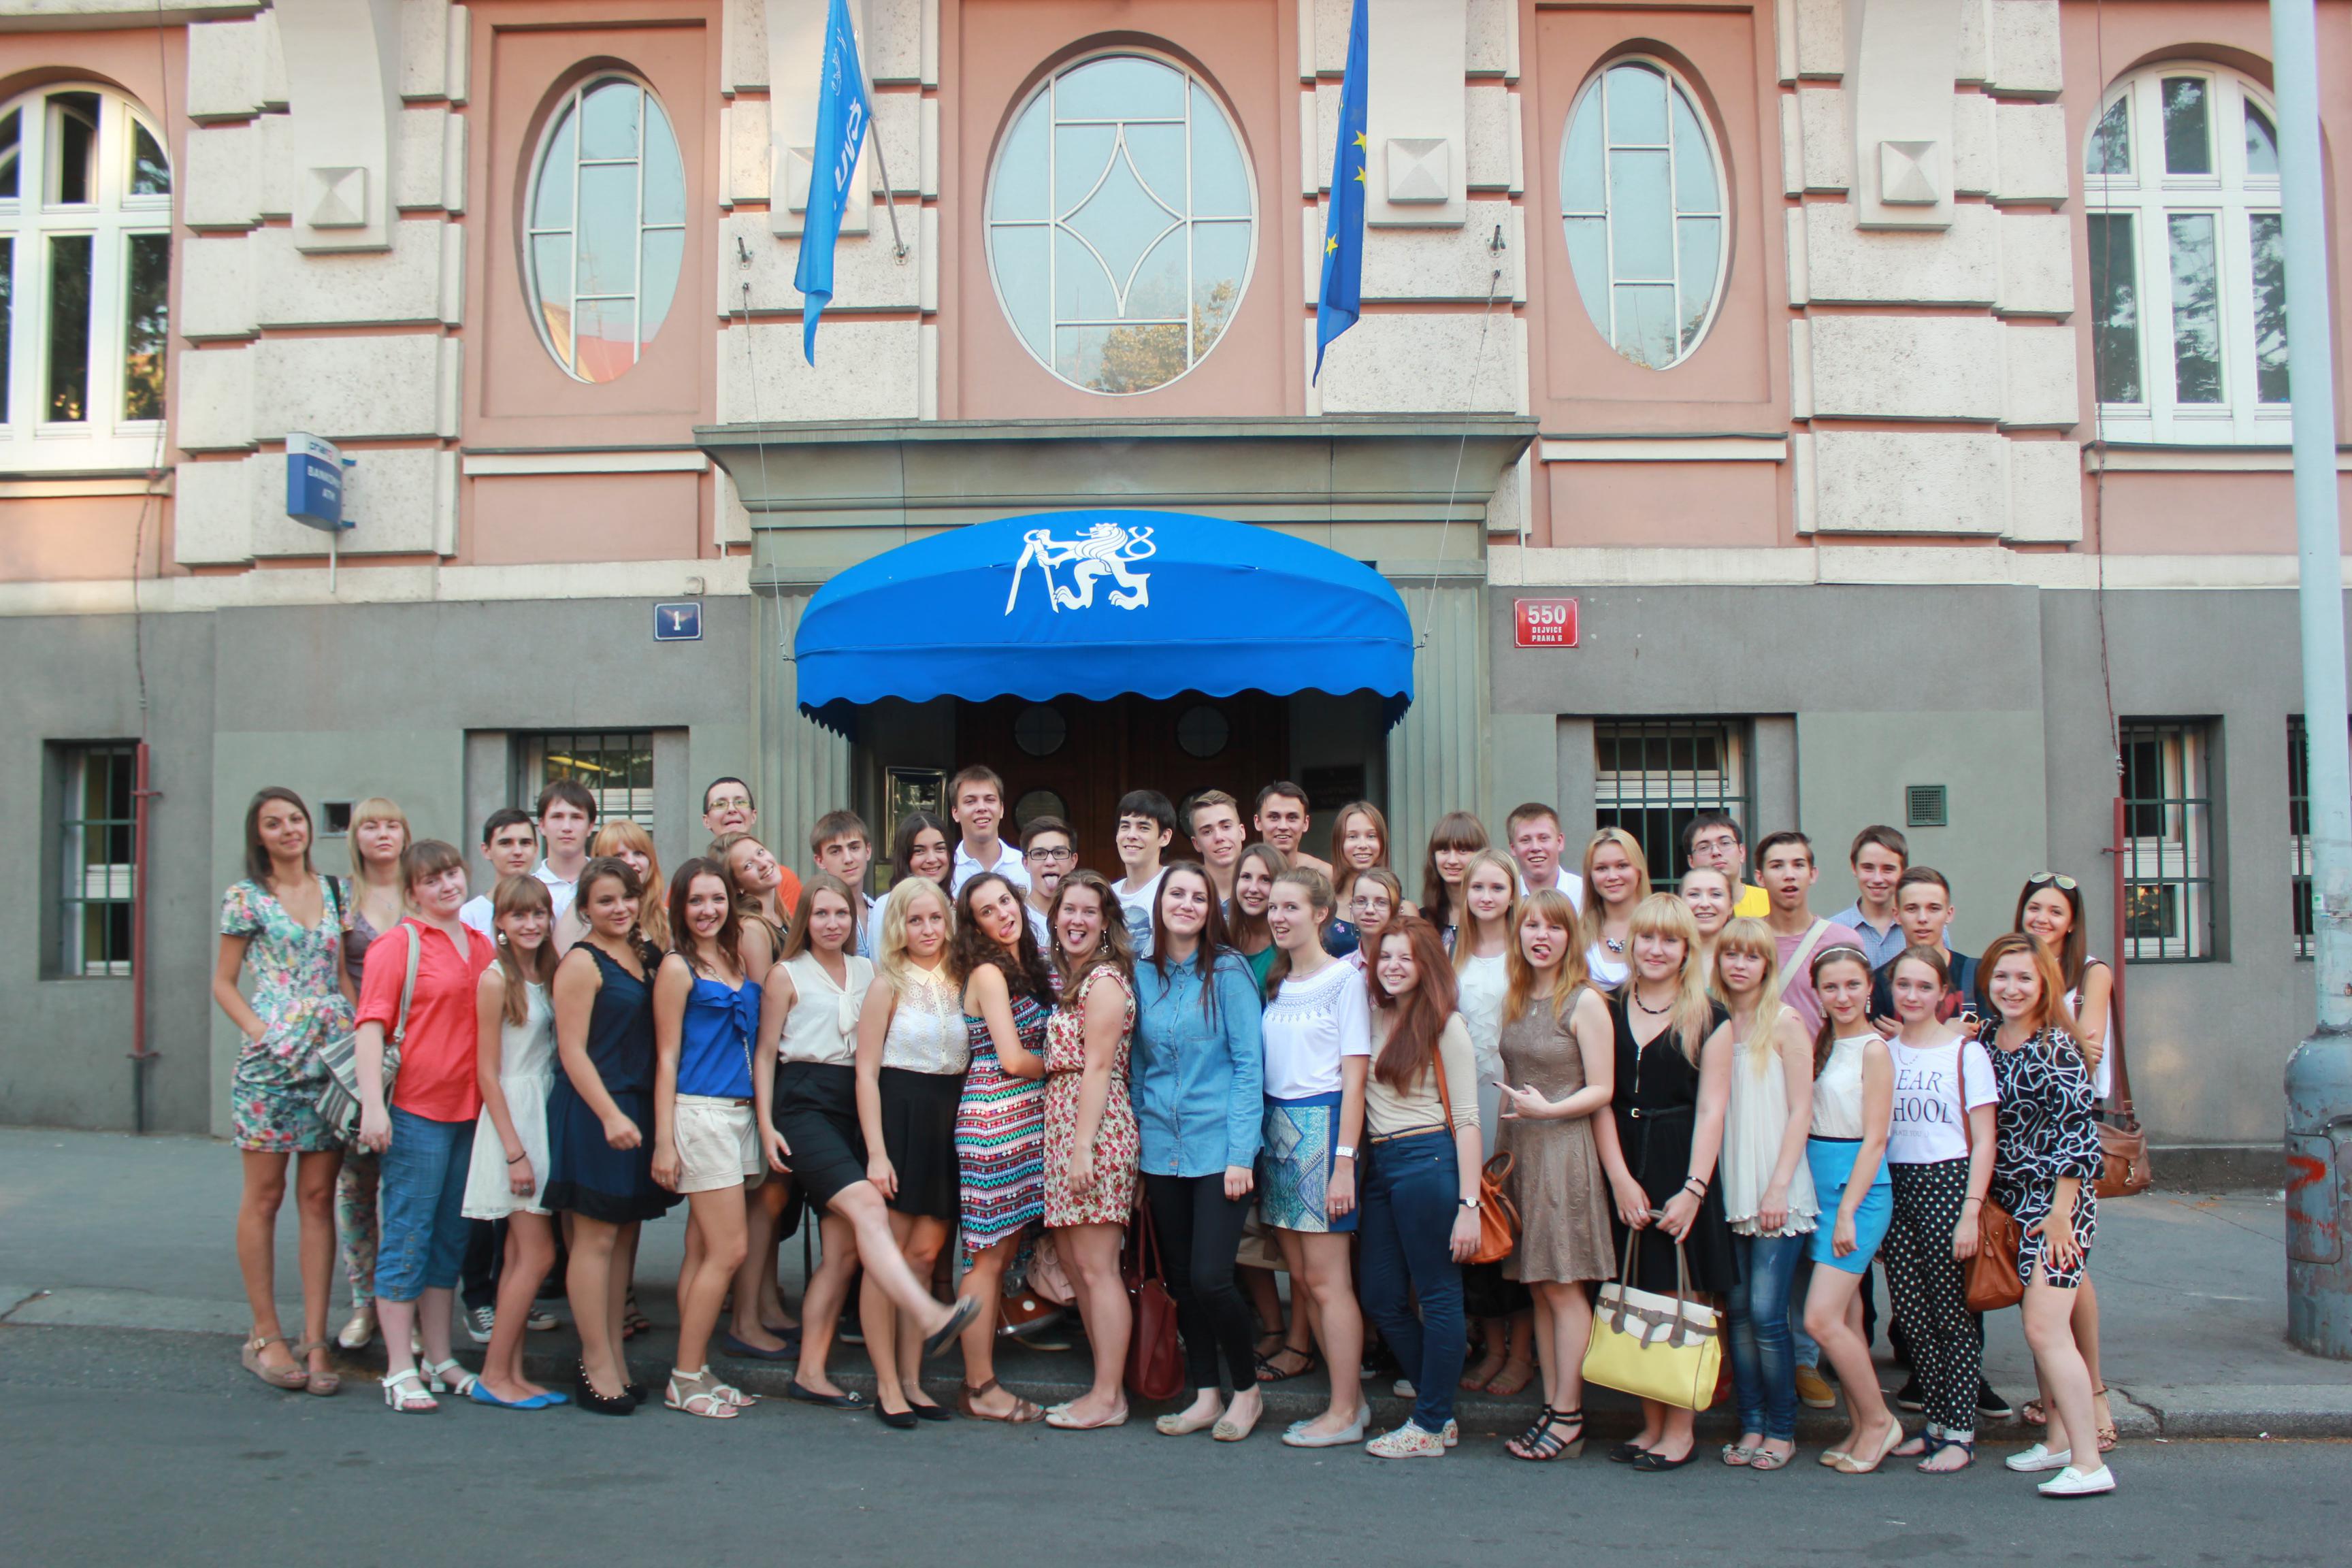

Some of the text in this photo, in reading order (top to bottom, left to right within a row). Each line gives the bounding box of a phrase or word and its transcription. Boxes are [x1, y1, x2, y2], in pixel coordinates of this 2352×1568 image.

[673, 610, 681, 631] 1
[1528, 605, 1566, 624] 550
[1896, 1069, 1942, 1093] EAR
[1893, 1097, 1953, 1124] HOOL
